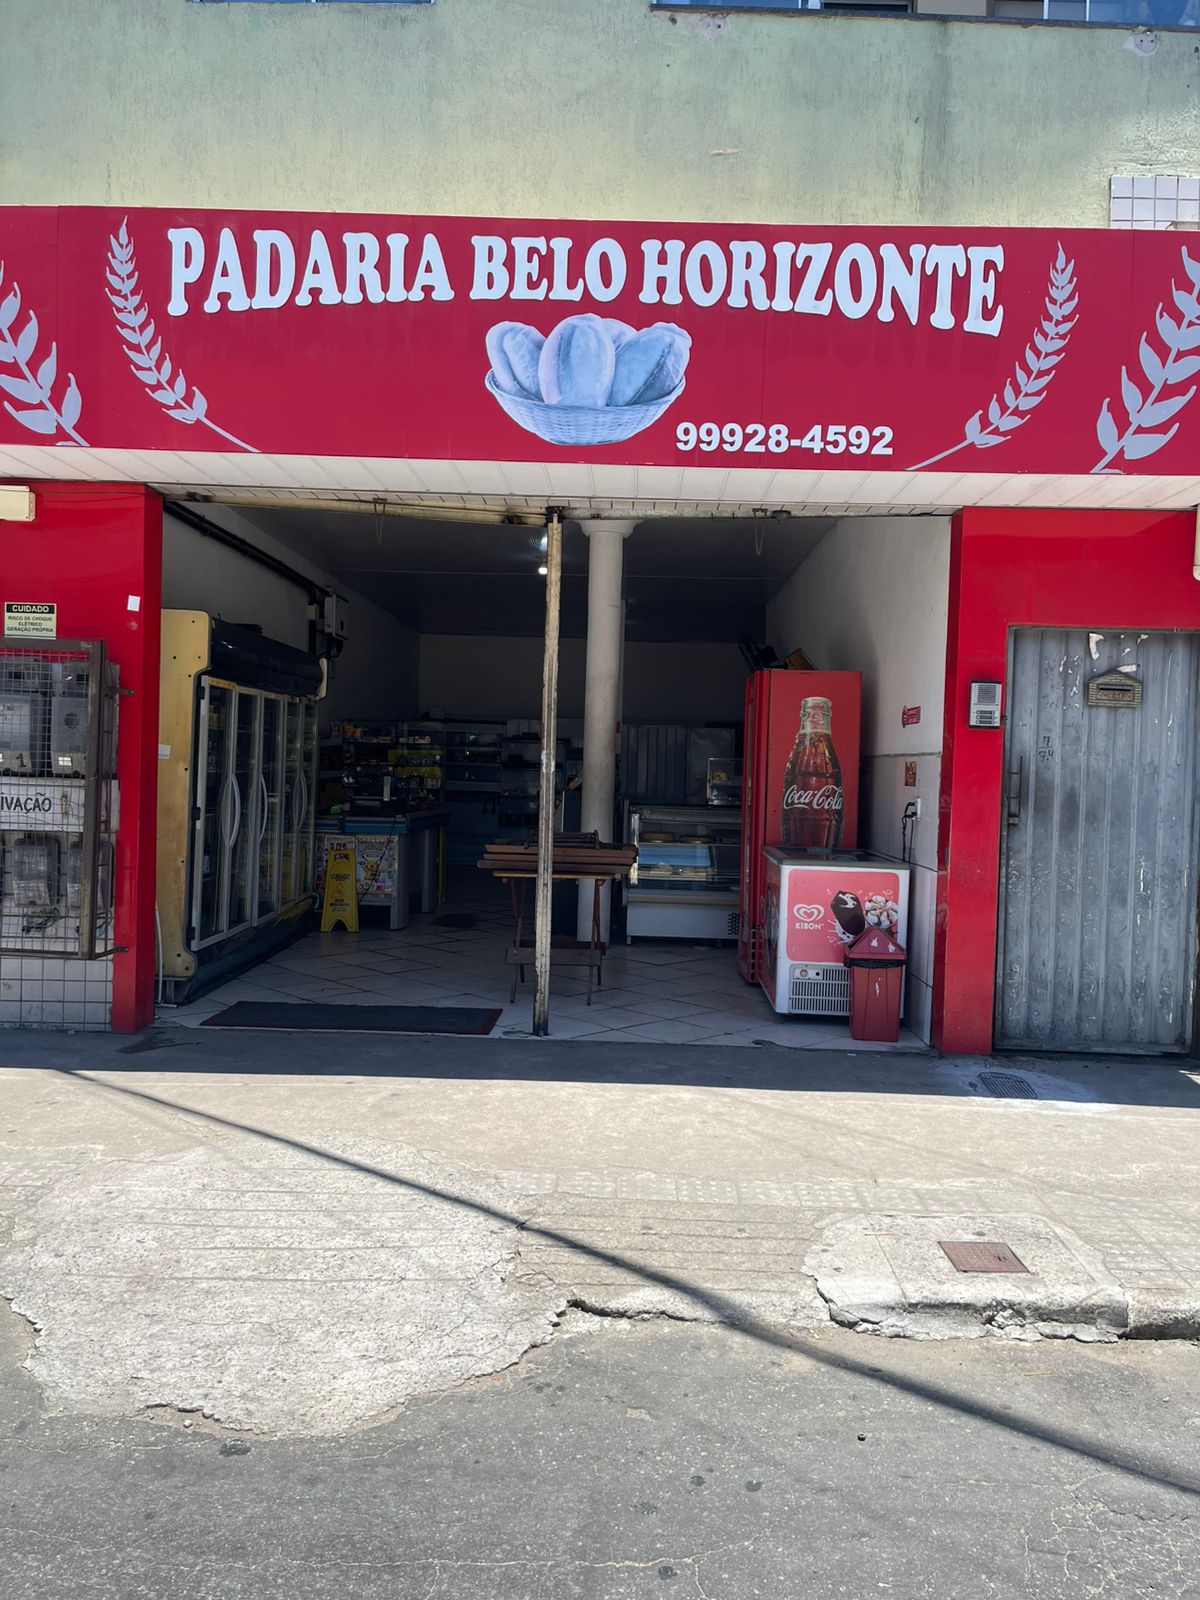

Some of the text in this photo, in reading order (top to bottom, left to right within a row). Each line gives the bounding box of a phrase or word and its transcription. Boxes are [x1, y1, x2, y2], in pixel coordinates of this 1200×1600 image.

[167, 228, 1005, 337] PADARIA BELO HORIZONTE
[676, 421, 894, 455] 99928-4592
[12, 605, 50, 613] CUIDADO
